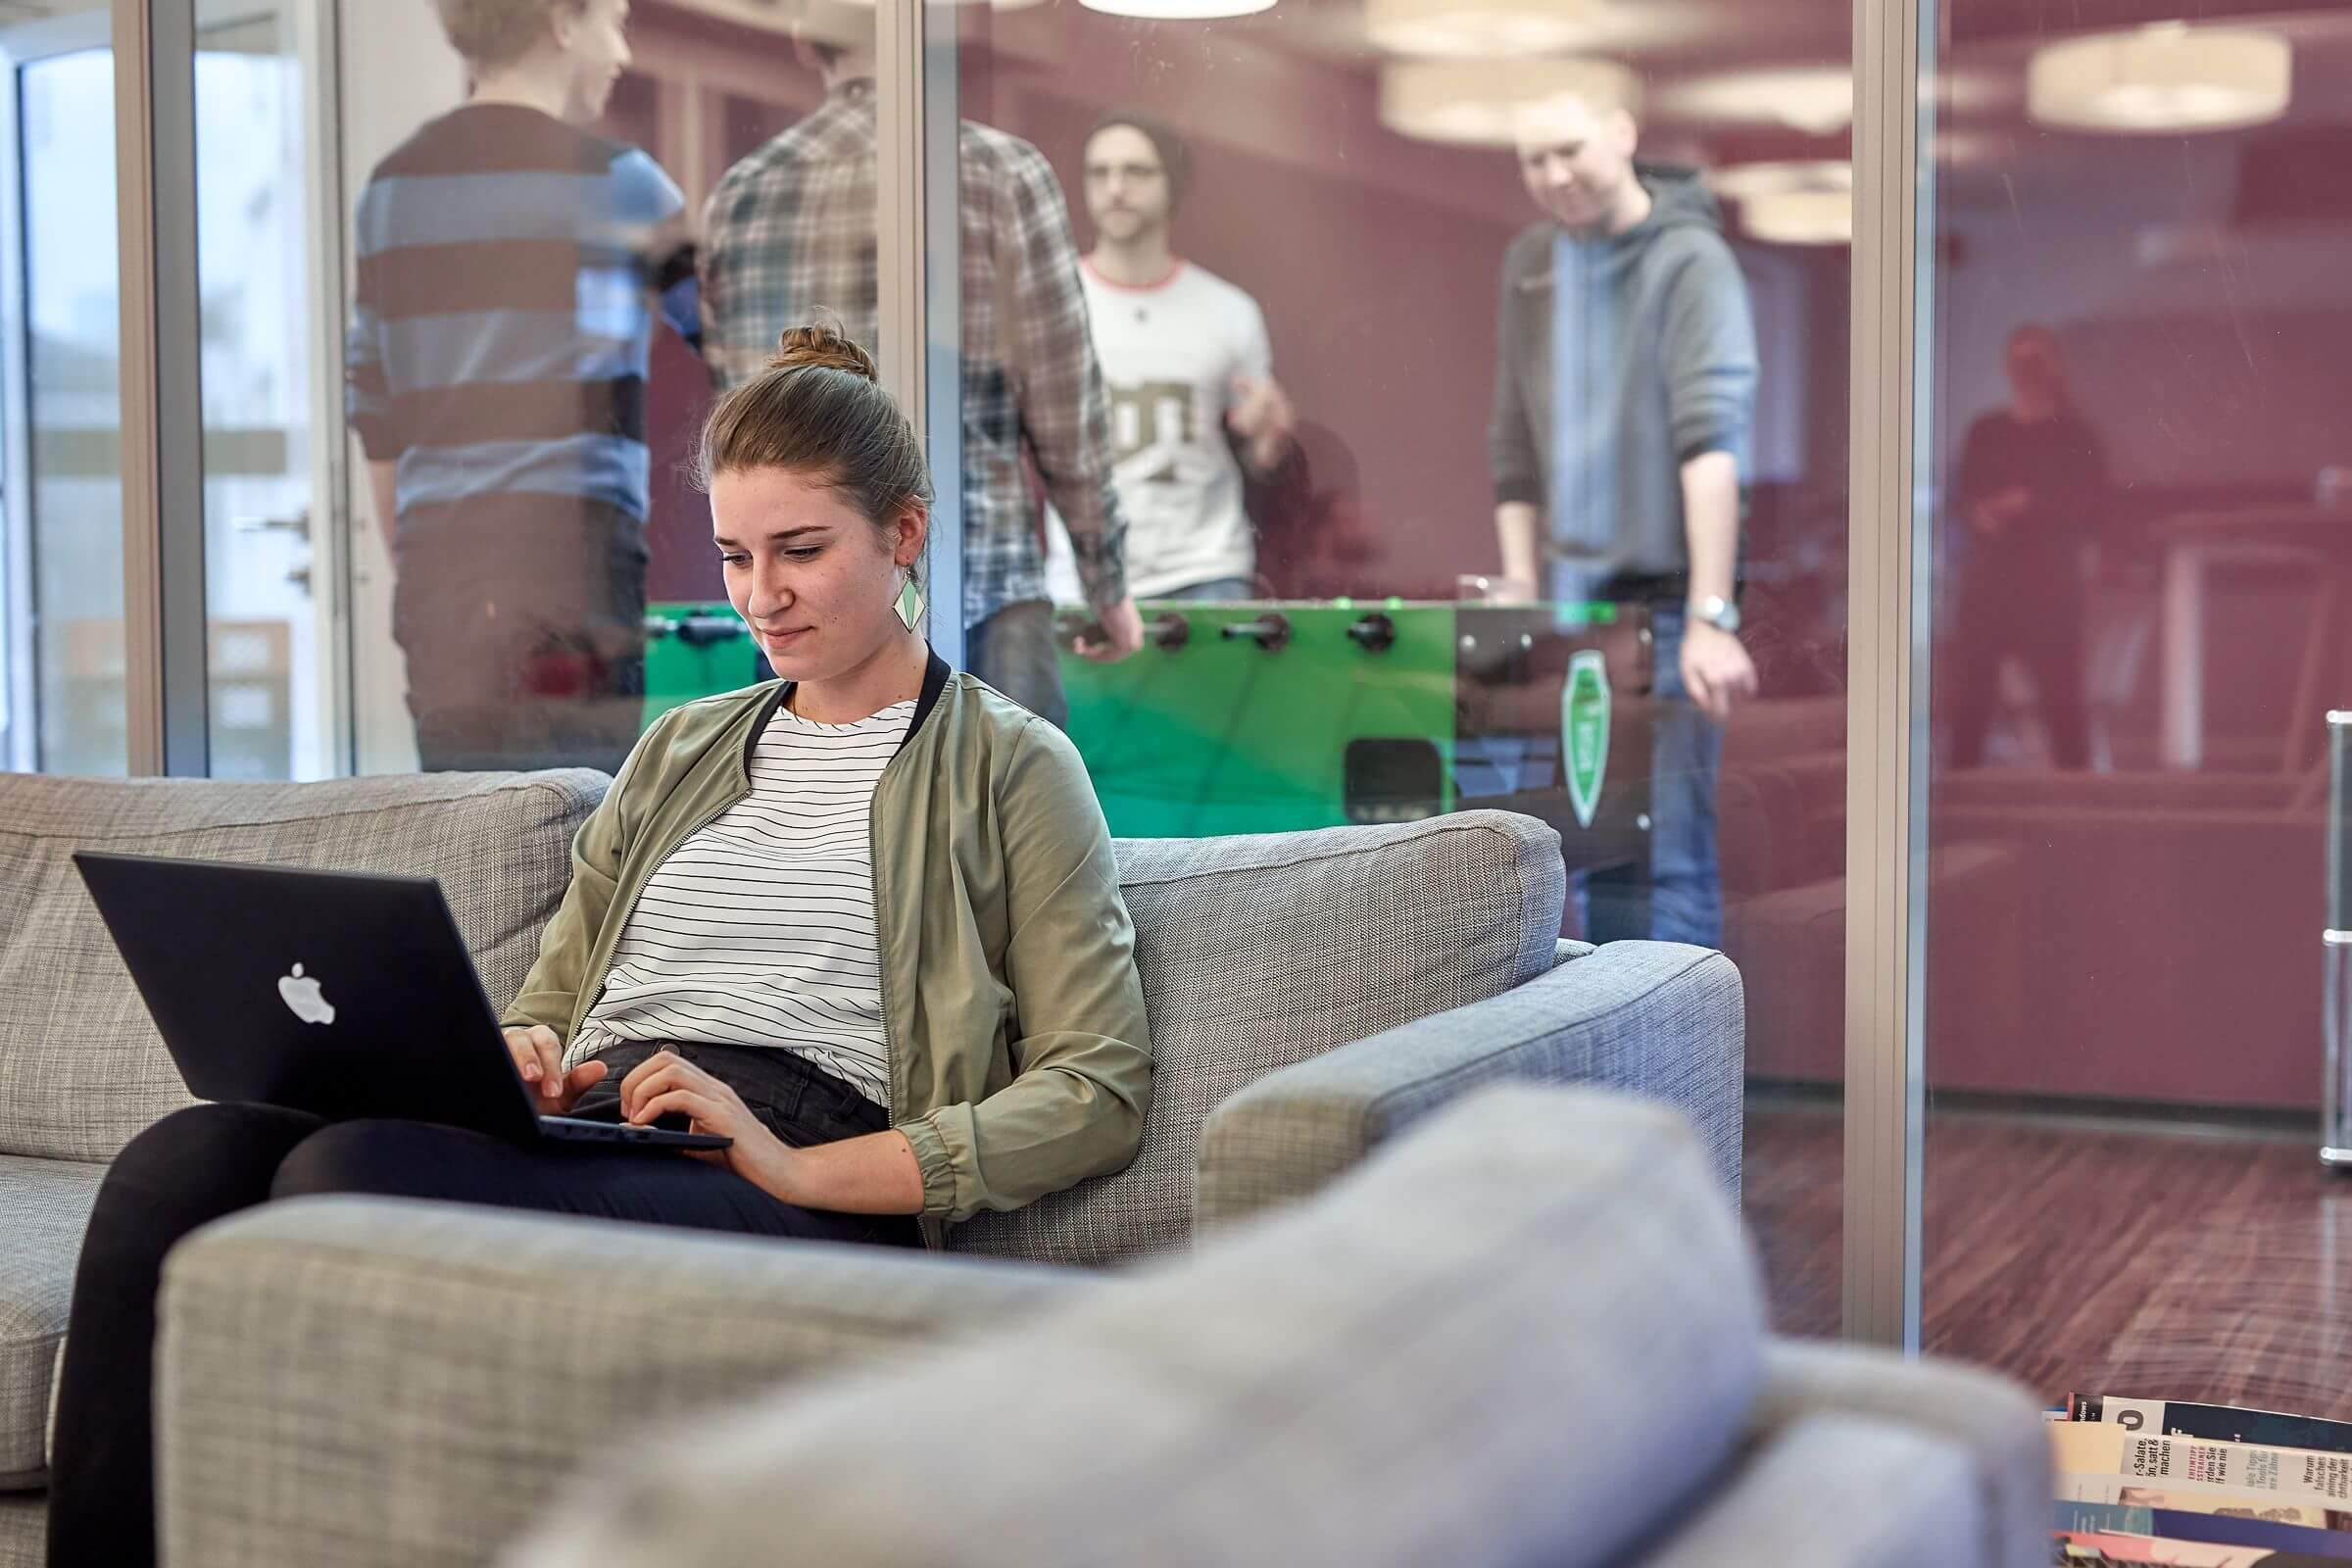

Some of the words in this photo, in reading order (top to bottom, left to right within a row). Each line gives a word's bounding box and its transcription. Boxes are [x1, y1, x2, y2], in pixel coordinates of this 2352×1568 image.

[2133, 1439, 2146, 1476] r-Salate,
[2148, 1446, 2158, 1463] satt
[2159, 1441, 2171, 1475] machen
[2206, 1446, 2216, 1460] Sie
[2218, 1448, 2227, 1461] nie
[2216, 1462, 2227, 1476] wie
[2303, 1455, 2314, 1483] Warum
[2328, 1457, 2338, 1471] der
[2314, 1456, 2326, 1491] falsches
